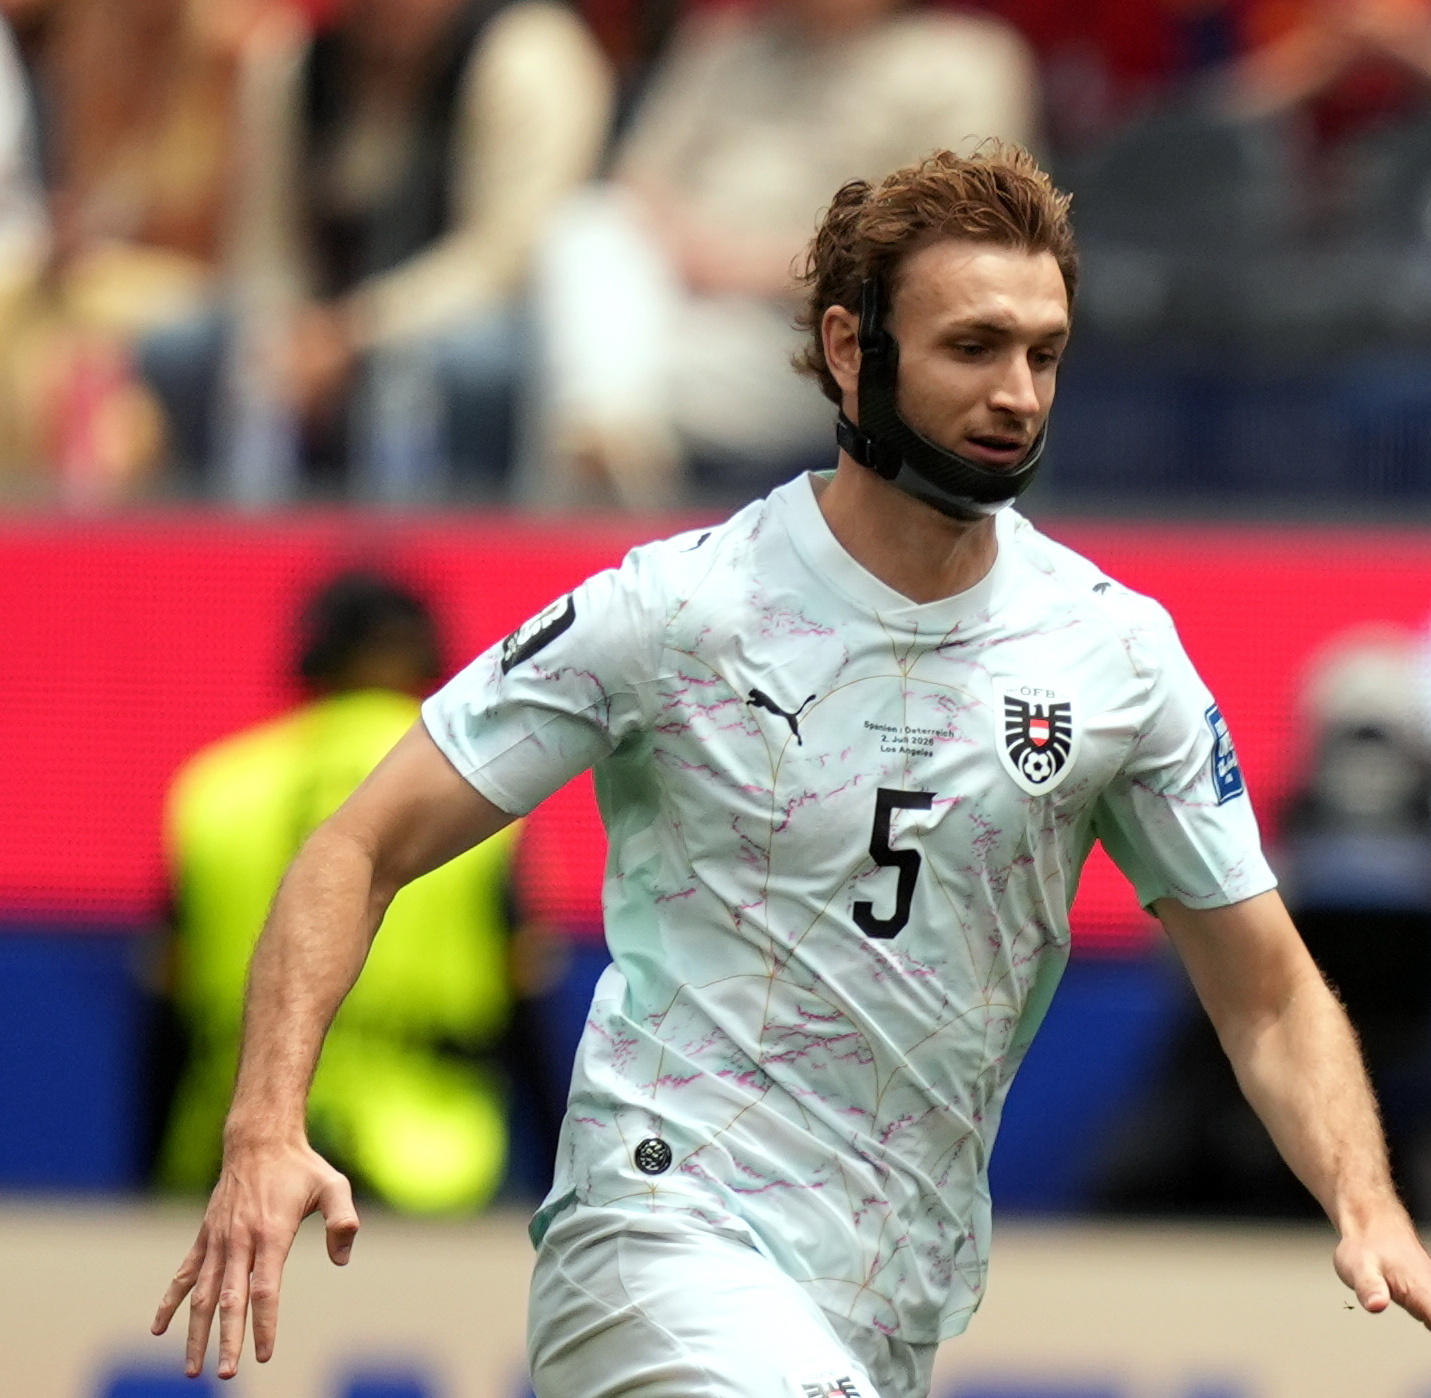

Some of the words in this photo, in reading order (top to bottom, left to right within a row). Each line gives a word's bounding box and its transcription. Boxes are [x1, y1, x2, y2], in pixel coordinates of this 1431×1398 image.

[911, 736, 934, 747] 2026
[880, 745, 897, 753] Los
[899, 746, 933, 757] Angeles
[852, 787, 938, 939] 5
